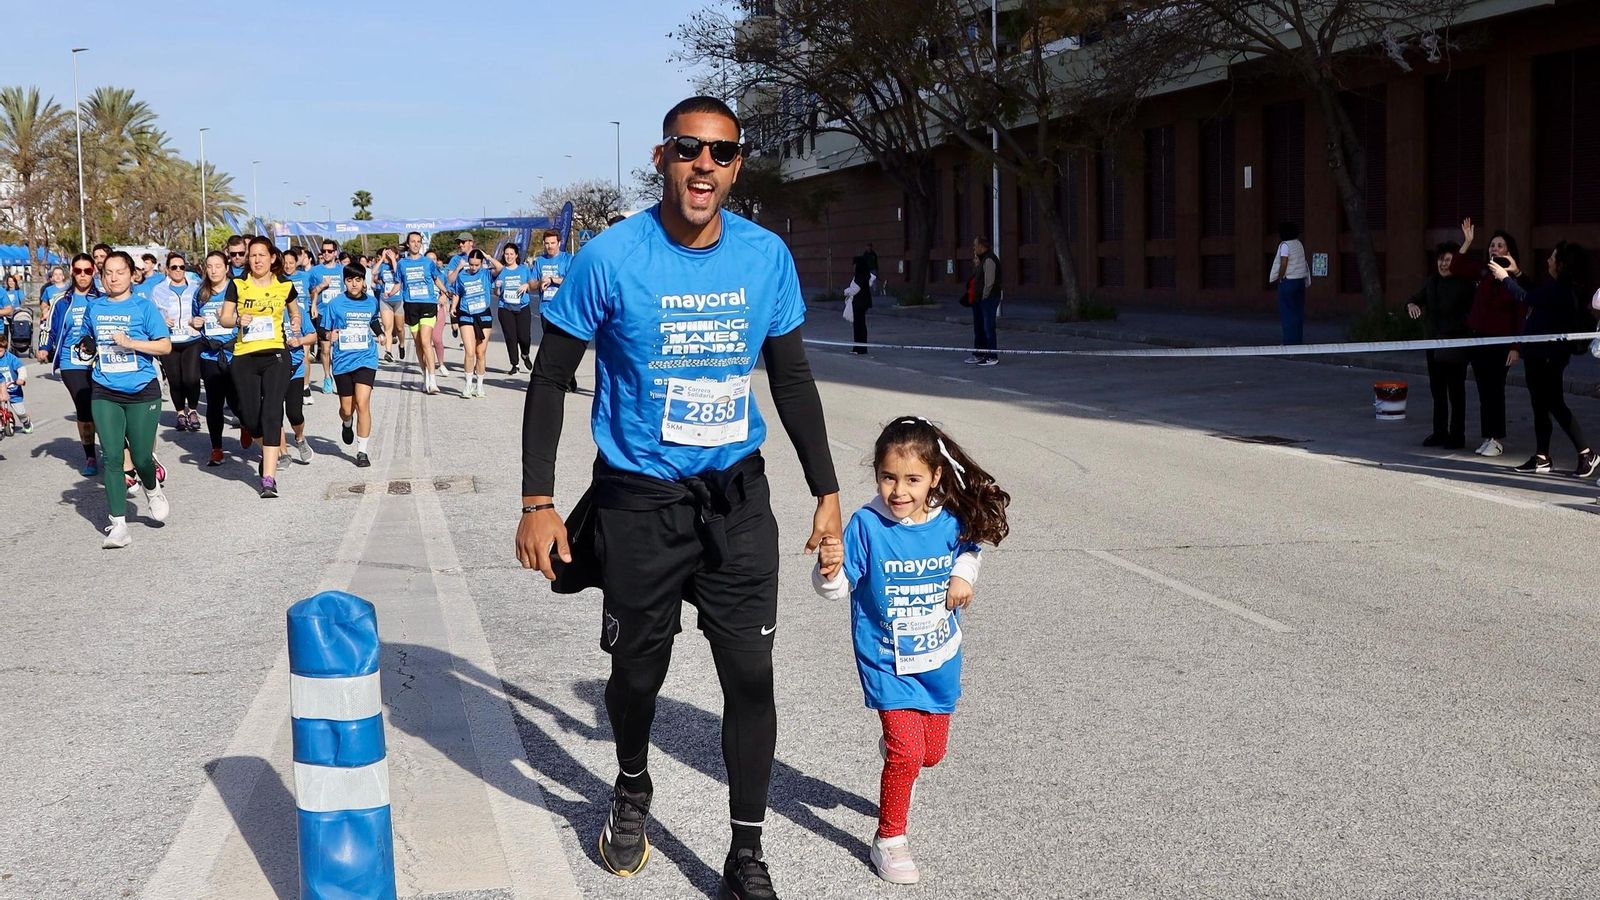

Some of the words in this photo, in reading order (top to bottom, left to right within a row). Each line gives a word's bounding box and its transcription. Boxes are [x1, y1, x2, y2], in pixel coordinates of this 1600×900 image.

[405, 221, 435, 231] mayoral
[661, 287, 746, 312] mayoral
[97, 314, 131, 322] mayoral
[660, 318, 746, 333] RUNNING
[669, 331, 739, 344] MAKES
[106, 354, 128, 362] 1863
[684, 400, 736, 423] 2858
[666, 422, 683, 431] 5KM
[884, 551, 954, 577] mayoral
[893, 590, 948, 607] MAKE
[887, 605, 936, 618] FRIEN
[913, 620, 951, 652] 2859
